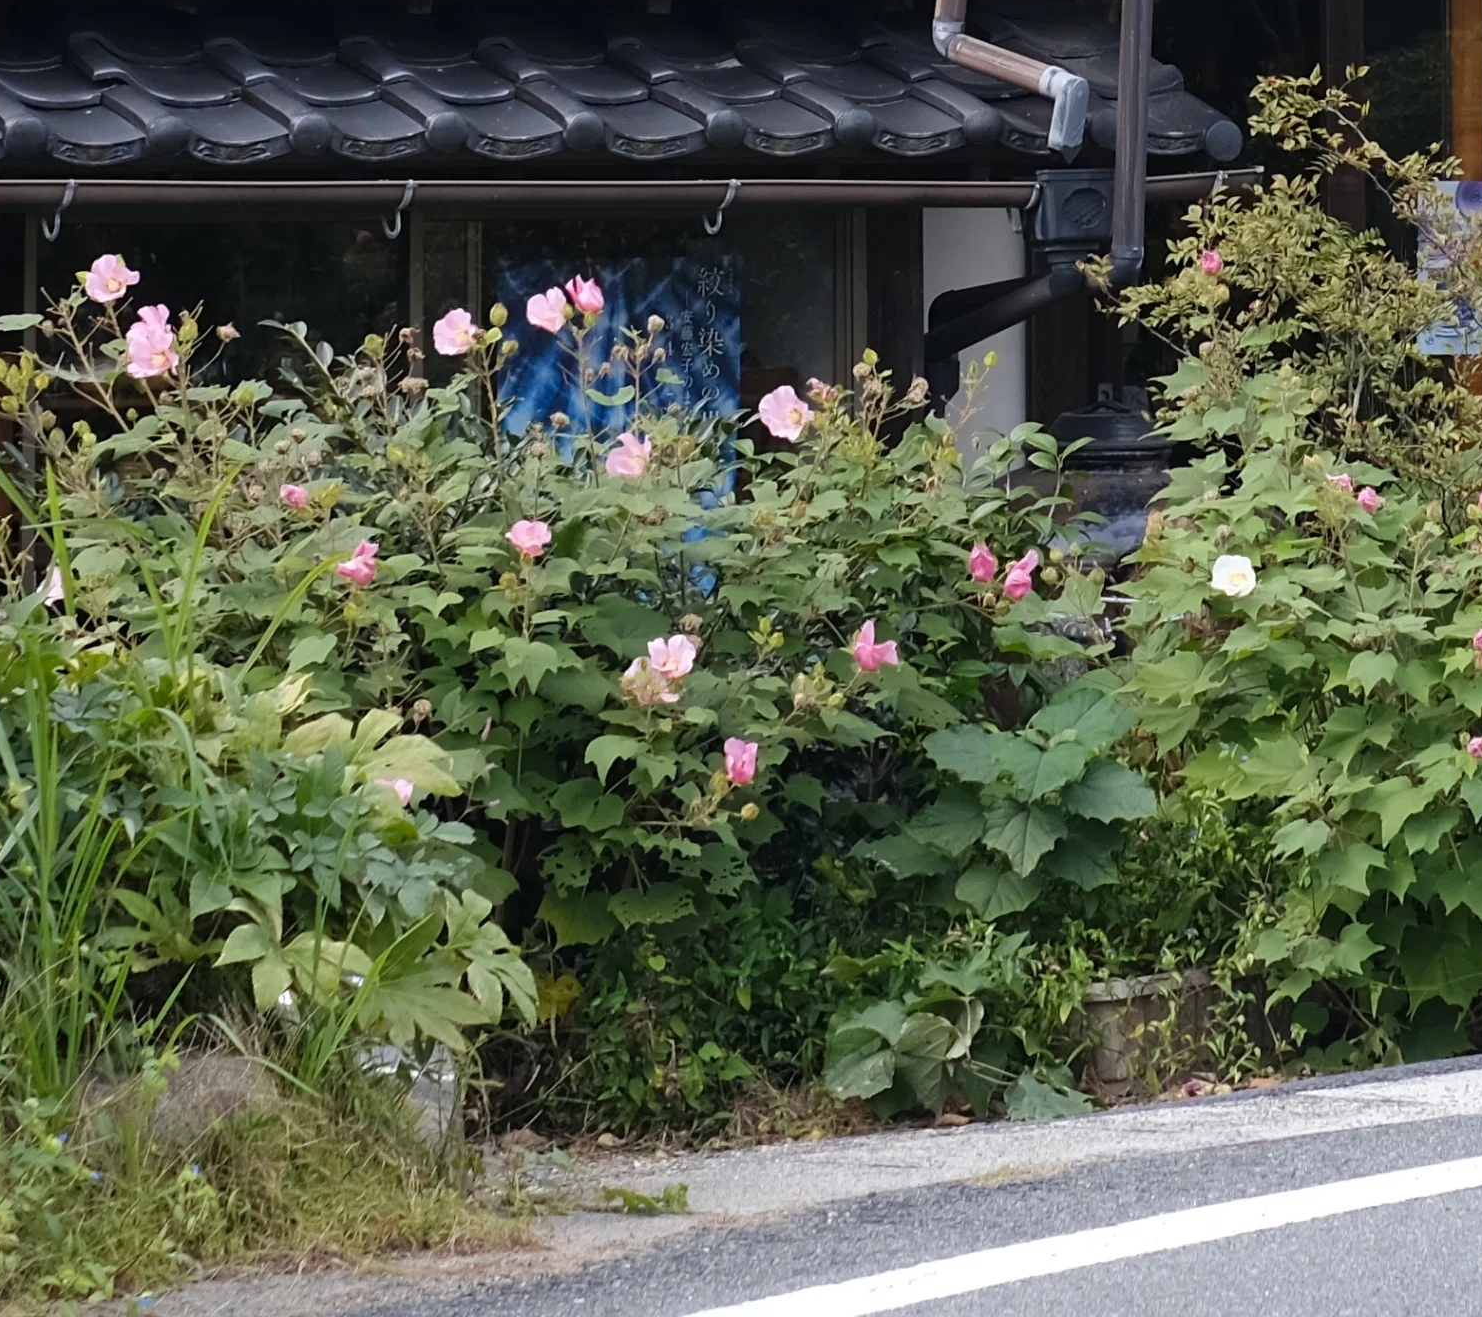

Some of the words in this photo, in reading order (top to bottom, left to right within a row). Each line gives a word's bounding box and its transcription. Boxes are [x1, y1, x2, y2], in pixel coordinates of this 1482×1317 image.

[697, 267, 724, 421] 絞り染めの
